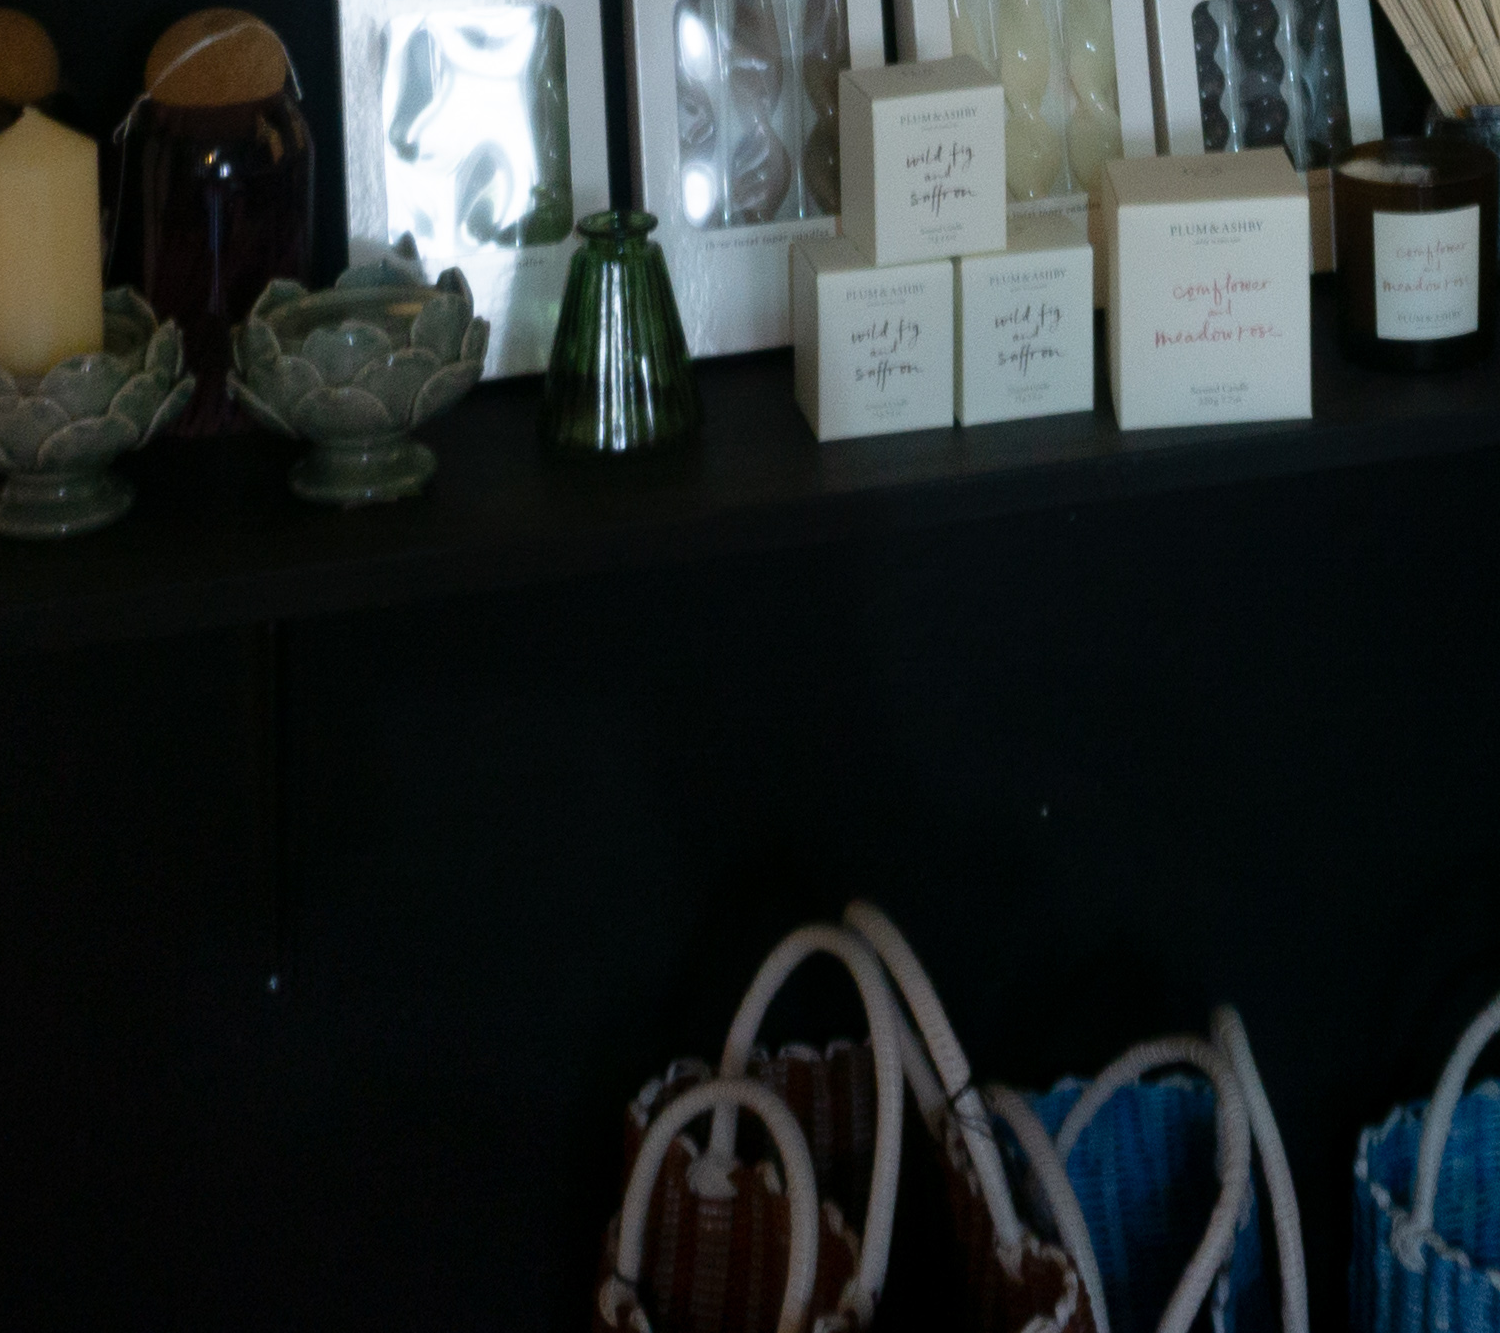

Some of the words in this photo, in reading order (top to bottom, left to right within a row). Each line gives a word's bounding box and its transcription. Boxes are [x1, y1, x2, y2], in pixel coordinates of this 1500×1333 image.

[905, 145, 944, 169] wild
[950, 143, 974, 167] fig
[924, 167, 952, 183] and
[908, 185, 977, 218] saffron
[1170, 222, 1207, 237] PLUM
[1209, 222, 1220, 235] &
[1221, 220, 1264, 234] ASHBY
[1172, 274, 1271, 305] cornflower
[994, 306, 1031, 329] wild
[1038, 303, 1063, 329] fig
[1208, 300, 1232, 318] and
[851, 322, 890, 345] wild
[897, 320, 921, 345] fig
[1012, 326, 1041, 341] and
[869, 342, 898, 357] and
[997, 342, 1065, 375] saffron
[854, 359, 923, 391] saffron
